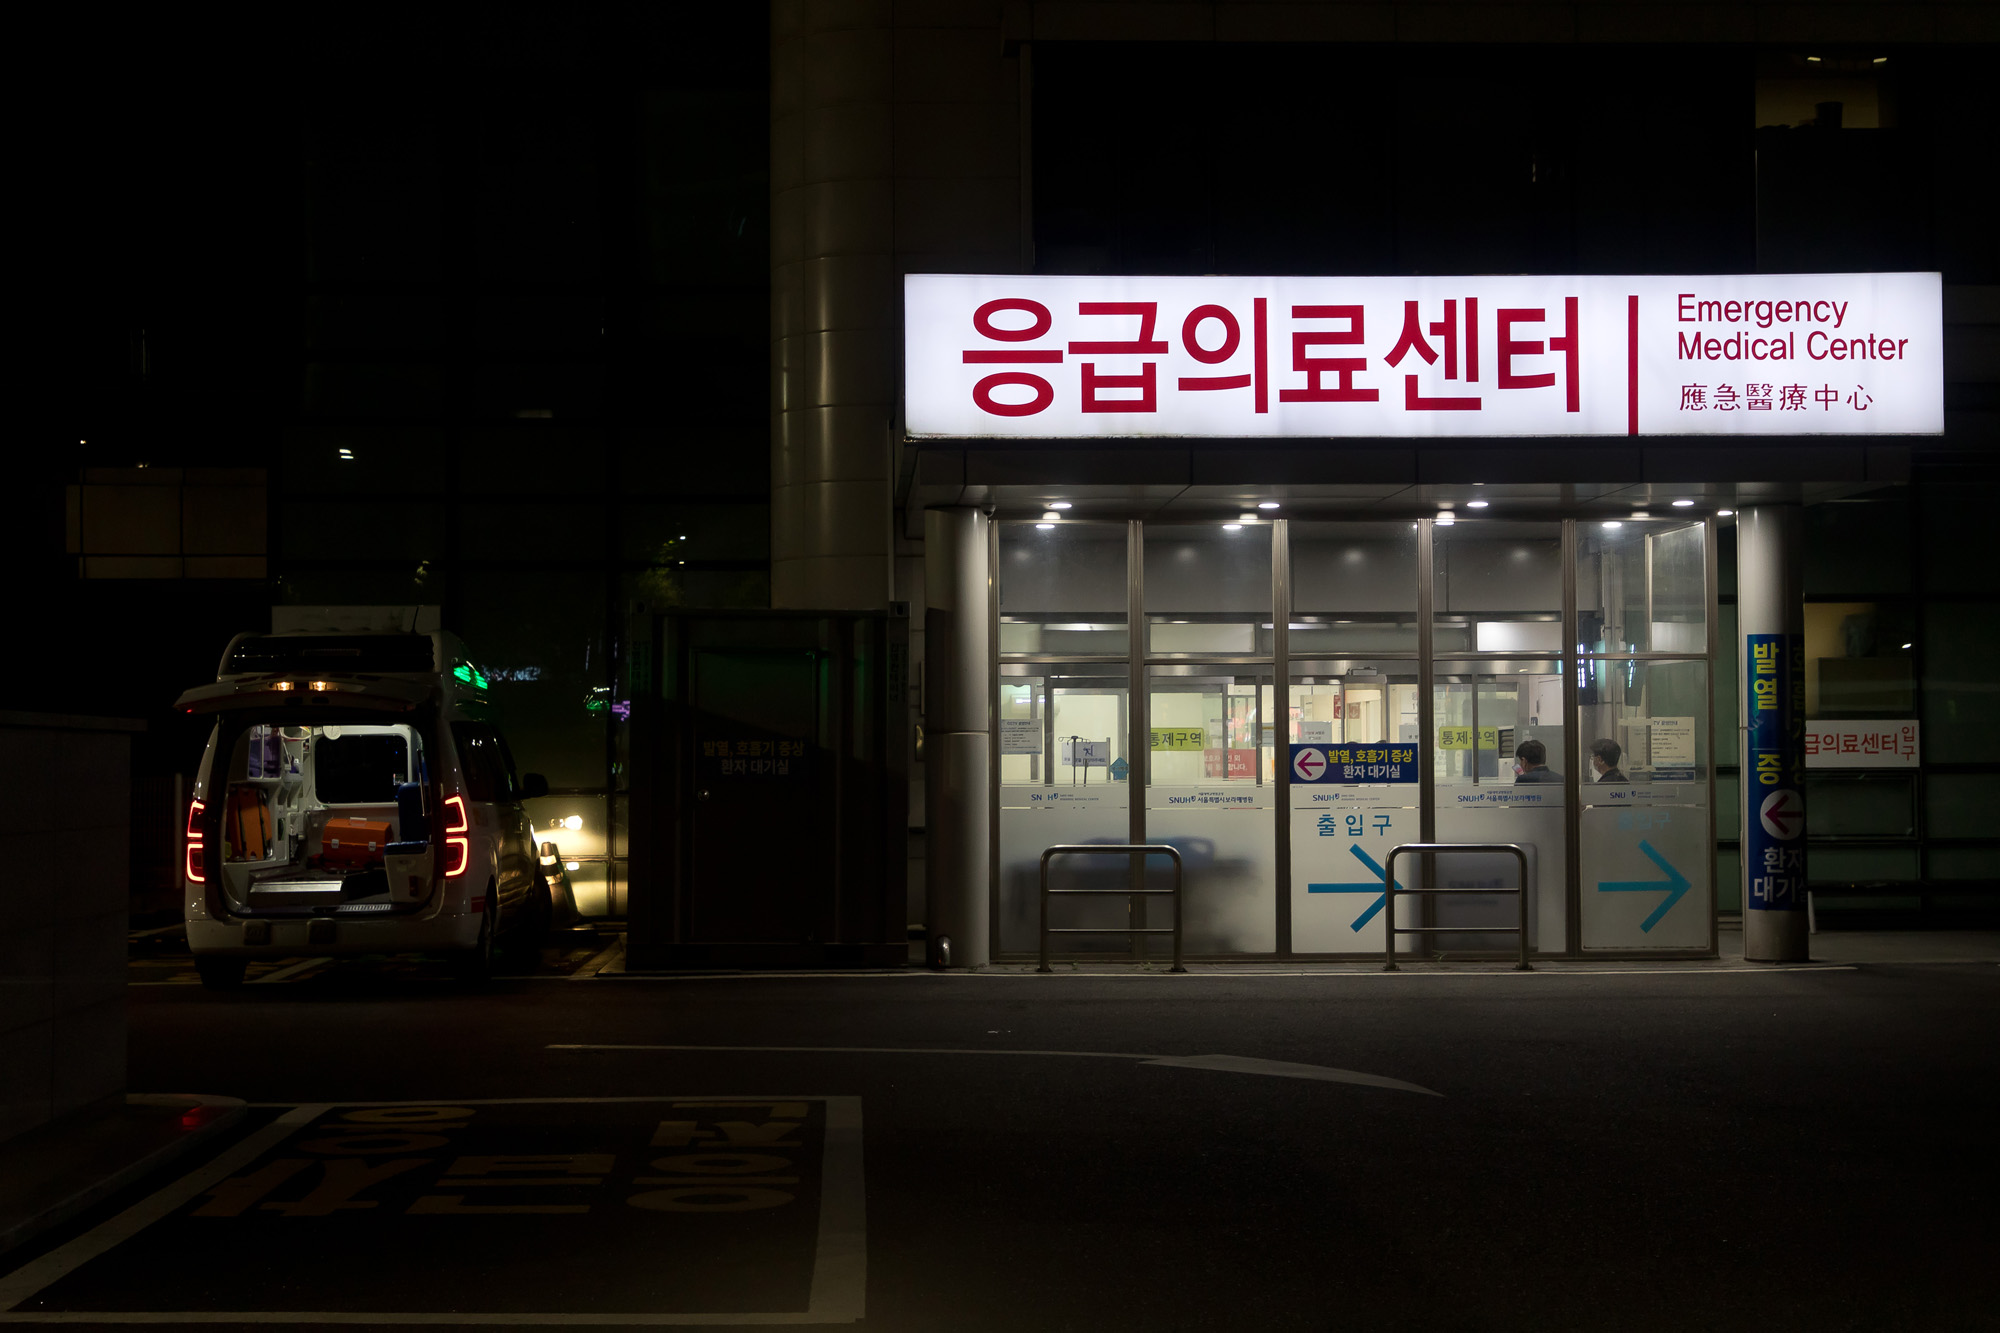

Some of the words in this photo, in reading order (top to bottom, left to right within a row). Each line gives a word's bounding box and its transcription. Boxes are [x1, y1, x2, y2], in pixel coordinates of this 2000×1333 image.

[1678, 293, 1848, 328] Emergency
[1678, 331, 1794, 360] Medical
[1807, 331, 1909, 361] Center
[962, 297, 1579, 417] 응급의료센터
[1679, 383, 1874, 411] 應急醫療中心
[736, 740, 776, 757] 호흡기
[780, 740, 805, 757] 증상
[1328, 749, 1354, 765] 발열,
[1355, 749, 1388, 763] 호흡기
[1391, 749, 1413, 763] 증상
[720, 758, 747, 776] 환자
[750, 758, 790, 776] 대기실
[1343, 764, 1365, 779] 환자
[1368, 764, 1400, 779] 대기실
[1031, 793, 1054, 801] SNH
[1168, 796, 1191, 804] SNUH
[1312, 794, 1334, 802] SNUH
[1457, 794, 1480, 802] SNUH
[1316, 814, 1393, 837] 출입구
